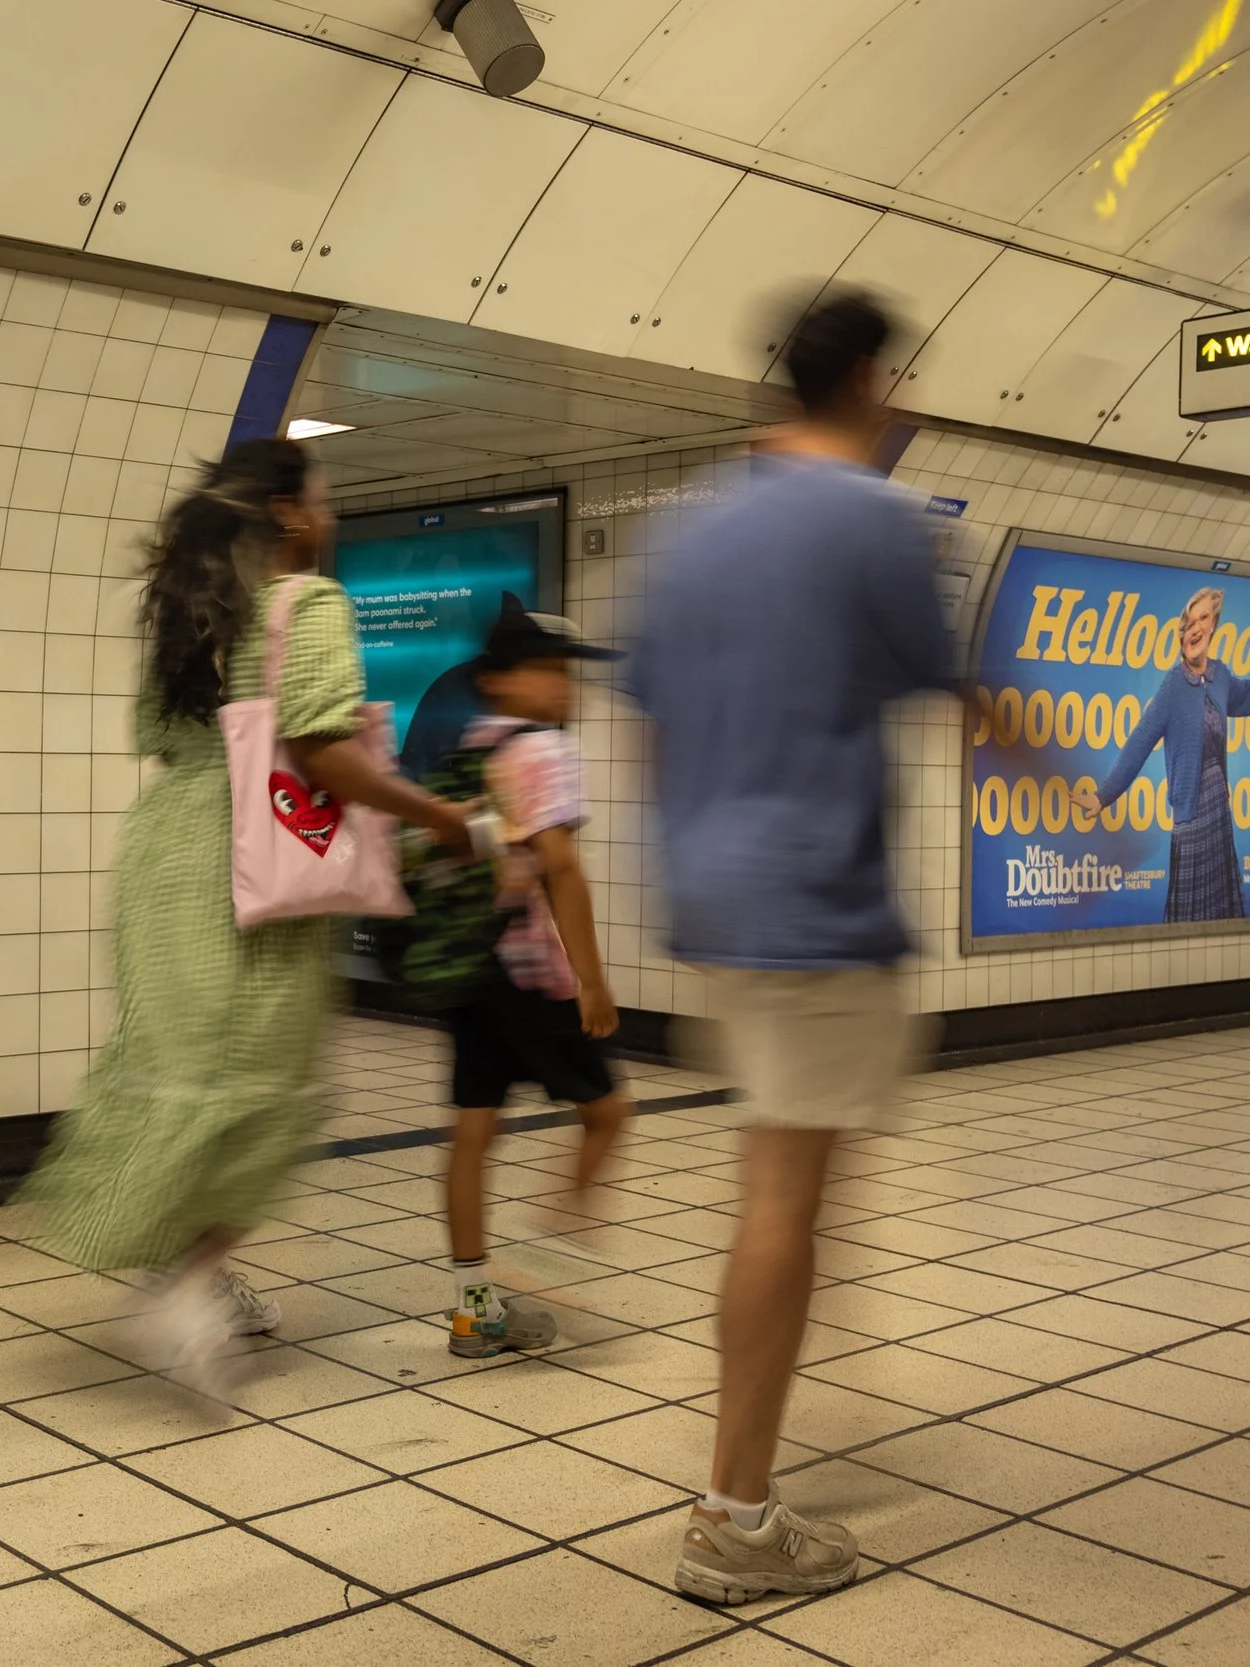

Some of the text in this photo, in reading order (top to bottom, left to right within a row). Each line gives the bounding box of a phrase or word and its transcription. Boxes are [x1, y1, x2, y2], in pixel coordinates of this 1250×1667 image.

[1225, 333, 1250, 357] W
[366, 596, 383, 604] mum
[399, 589, 438, 602] babysitting
[438, 588, 459, 598] when
[459, 587, 472, 597] the
[403, 605, 427, 614] struck.
[354, 623, 367, 632] She
[368, 623, 387, 631] never
[388, 620, 414, 629] offered
[1025, 845, 1058, 867] Mrs.
[1006, 853, 1122, 897] Doubtfire
[1006, 895, 1079, 908] The New Comedy Musical
[780, 1527, 804, 1559] N
